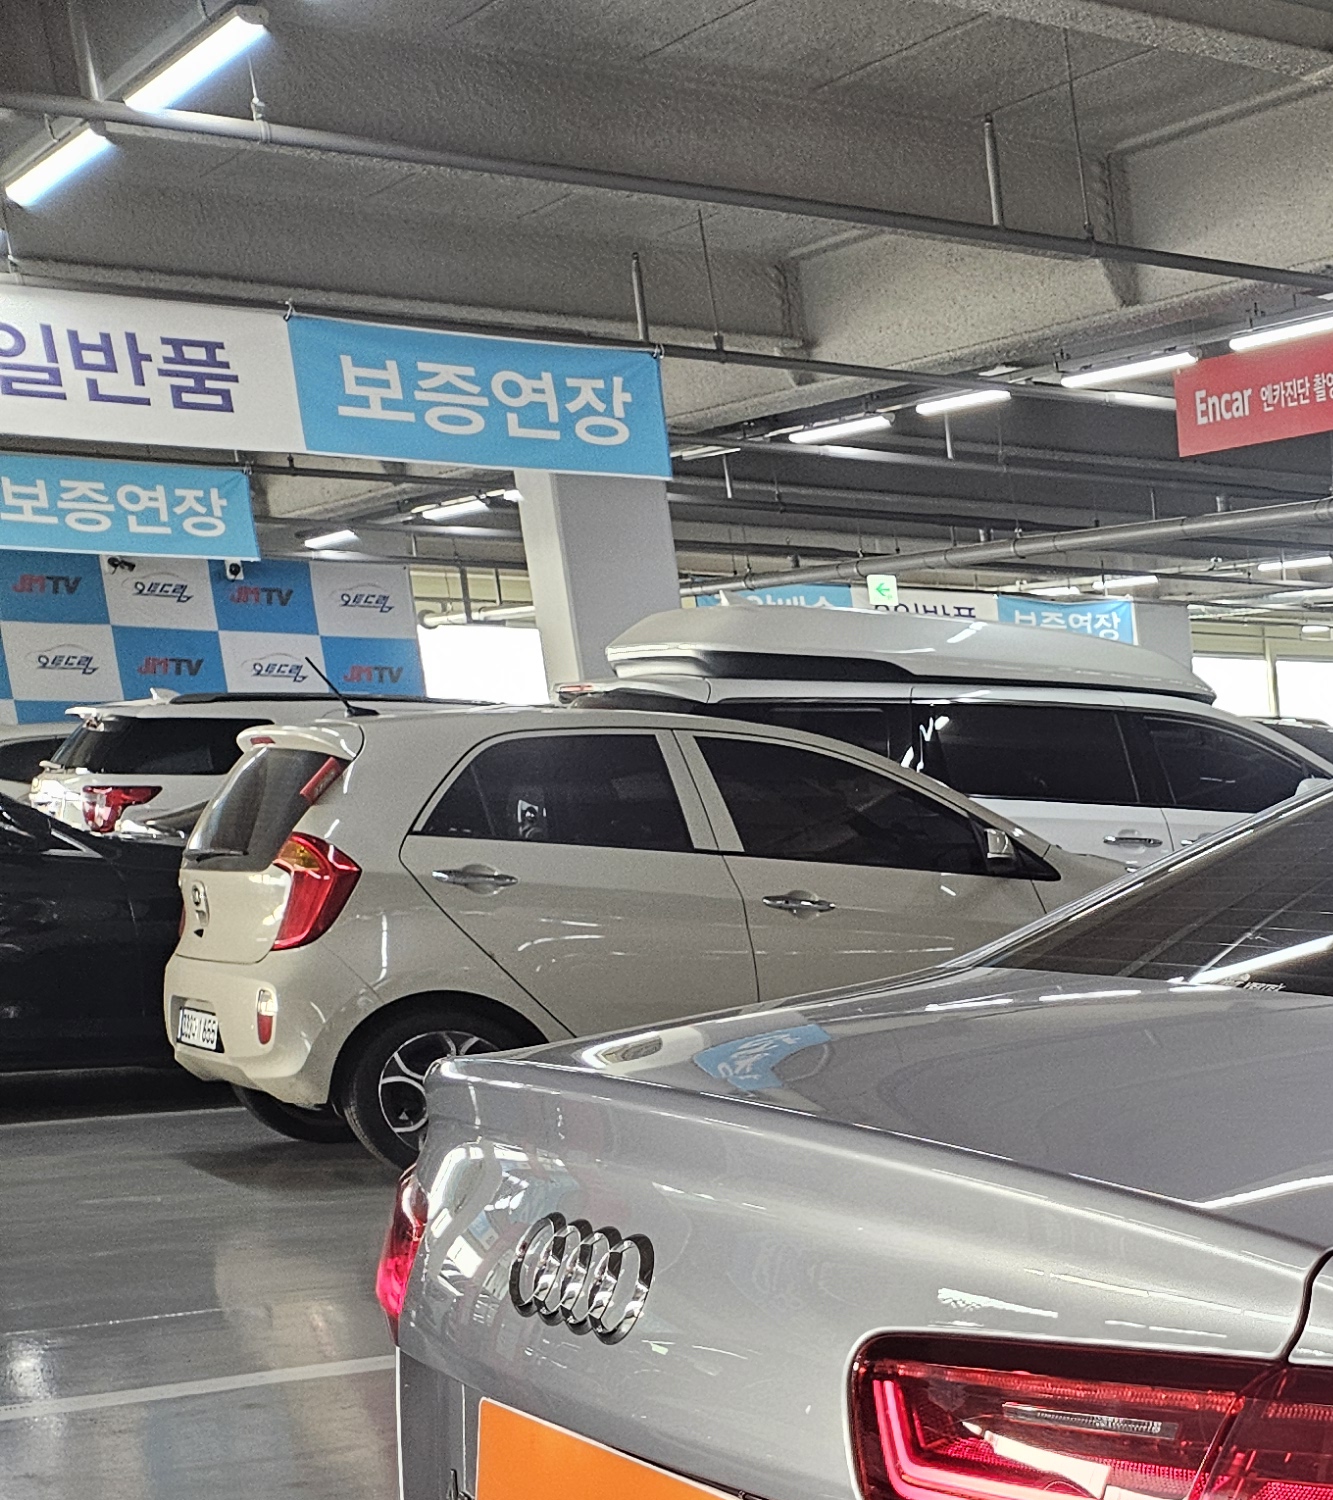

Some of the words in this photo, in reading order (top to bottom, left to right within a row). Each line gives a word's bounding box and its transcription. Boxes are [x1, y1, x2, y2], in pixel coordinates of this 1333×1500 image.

[0, 322, 239, 413] 일반품
[337, 354, 633, 446] 보증연장
[1194, 387, 1252, 426] Encar
[1260, 376, 1311, 413] 엔카진단
[1, 475, 228, 538] 보증연장
